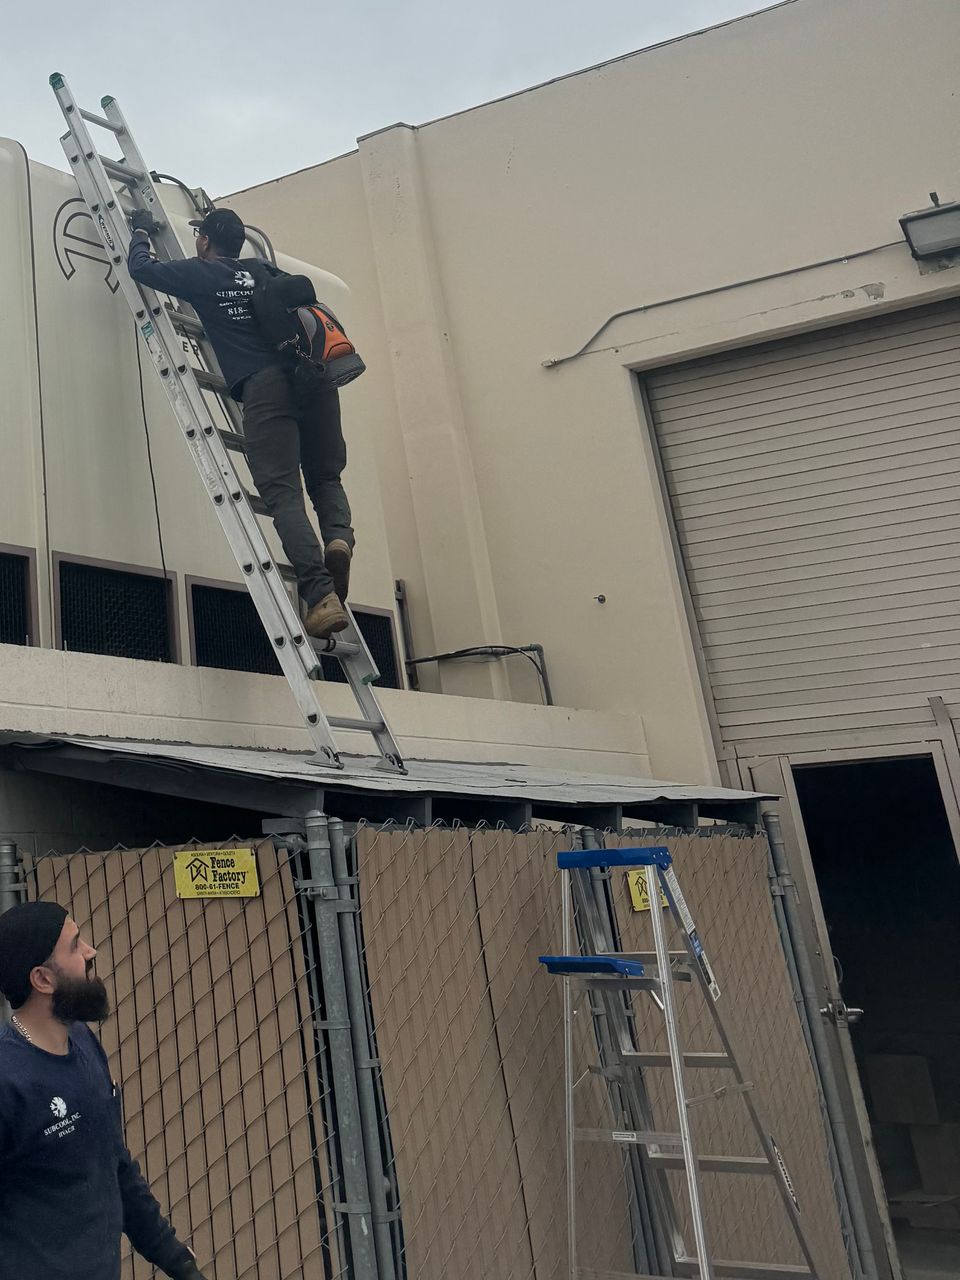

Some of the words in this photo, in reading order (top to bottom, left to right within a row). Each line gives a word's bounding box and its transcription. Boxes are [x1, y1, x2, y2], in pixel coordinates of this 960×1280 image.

[216, 290, 254, 298] SUBCOO
[227, 306, 248, 315] 818-
[210, 856, 235, 869] Fence
[212, 870, 246, 884] Factory
[195, 882, 240, 891] 800-61-FENCE
